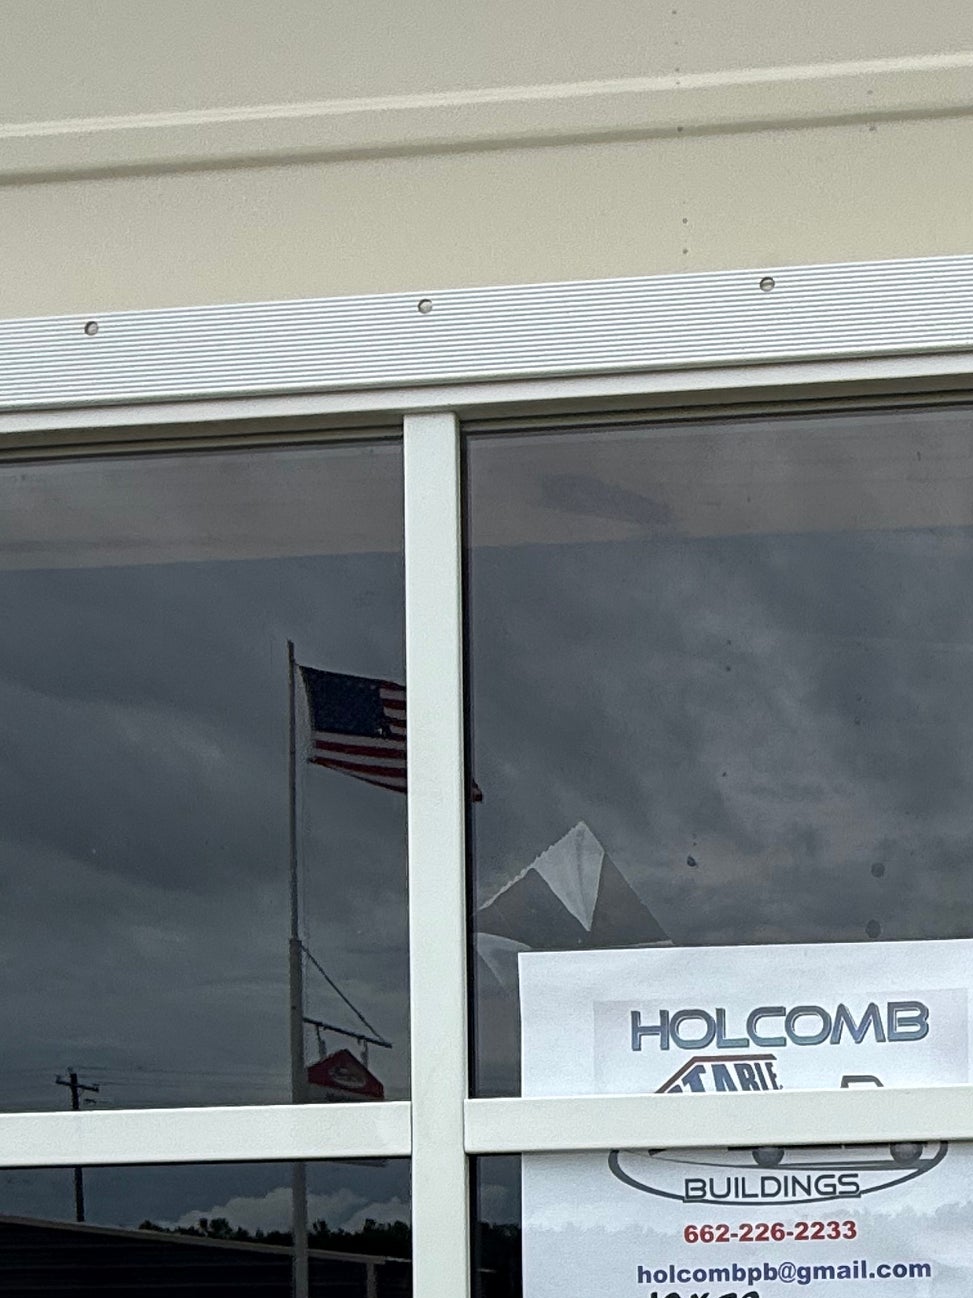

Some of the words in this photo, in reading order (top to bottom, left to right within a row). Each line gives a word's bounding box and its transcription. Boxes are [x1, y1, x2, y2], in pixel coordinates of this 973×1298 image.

[631, 1001, 929, 1051] HOLCOMB
[684, 1174, 860, 1199] BUILDINGS
[683, 1221, 857, 1243] 662-226-2233
[637, 1260, 932, 1285] holcombpb@gmail.com
